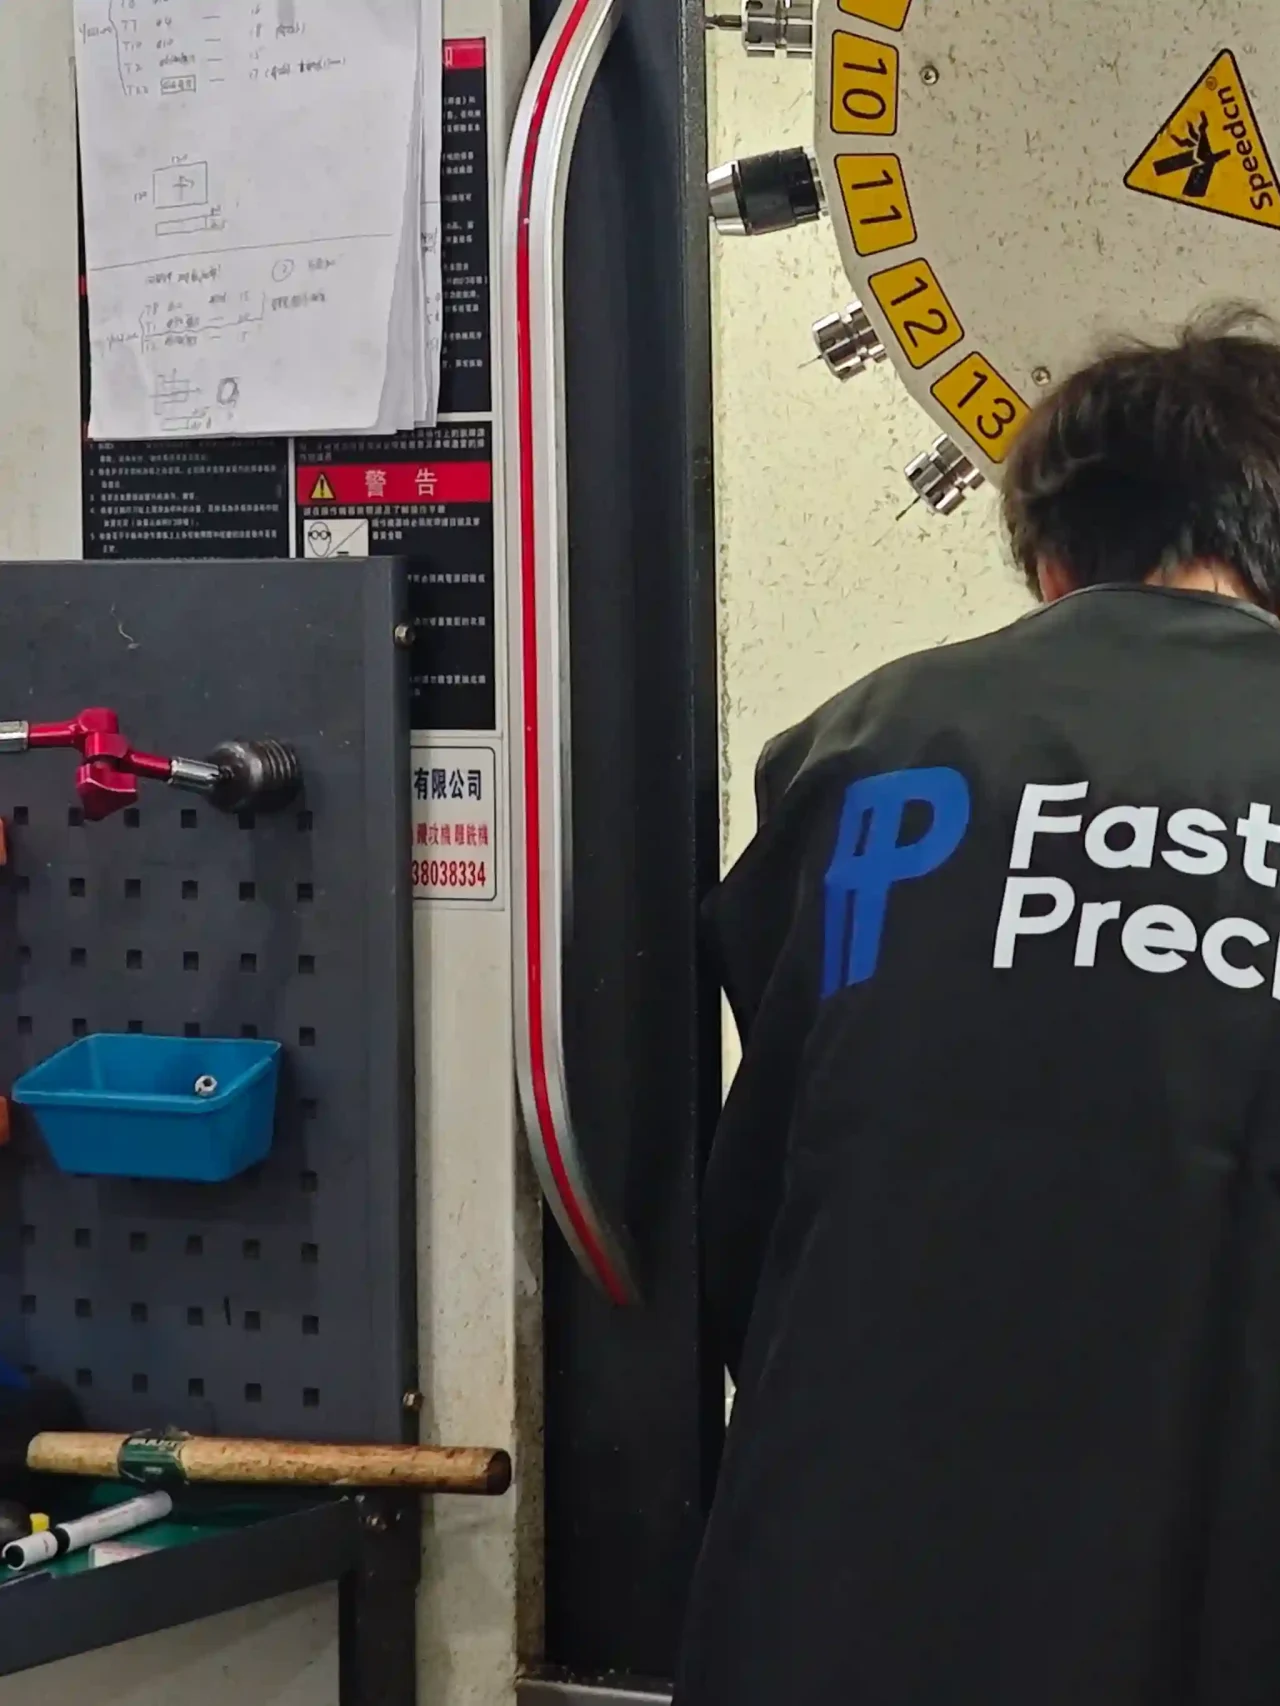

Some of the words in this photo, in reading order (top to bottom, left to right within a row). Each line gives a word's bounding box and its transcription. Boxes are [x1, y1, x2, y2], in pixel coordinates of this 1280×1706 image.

[842, 58, 887, 120] 10
[1217, 86, 1275, 210] Speedcn
[851, 170, 903, 225] 11
[889, 276, 948, 349] 12
[957, 370, 1016, 440] 13
[364, 467, 439, 498] 警告
[414, 767, 482, 801] 有限公司
[411, 859, 486, 888] 38038334
